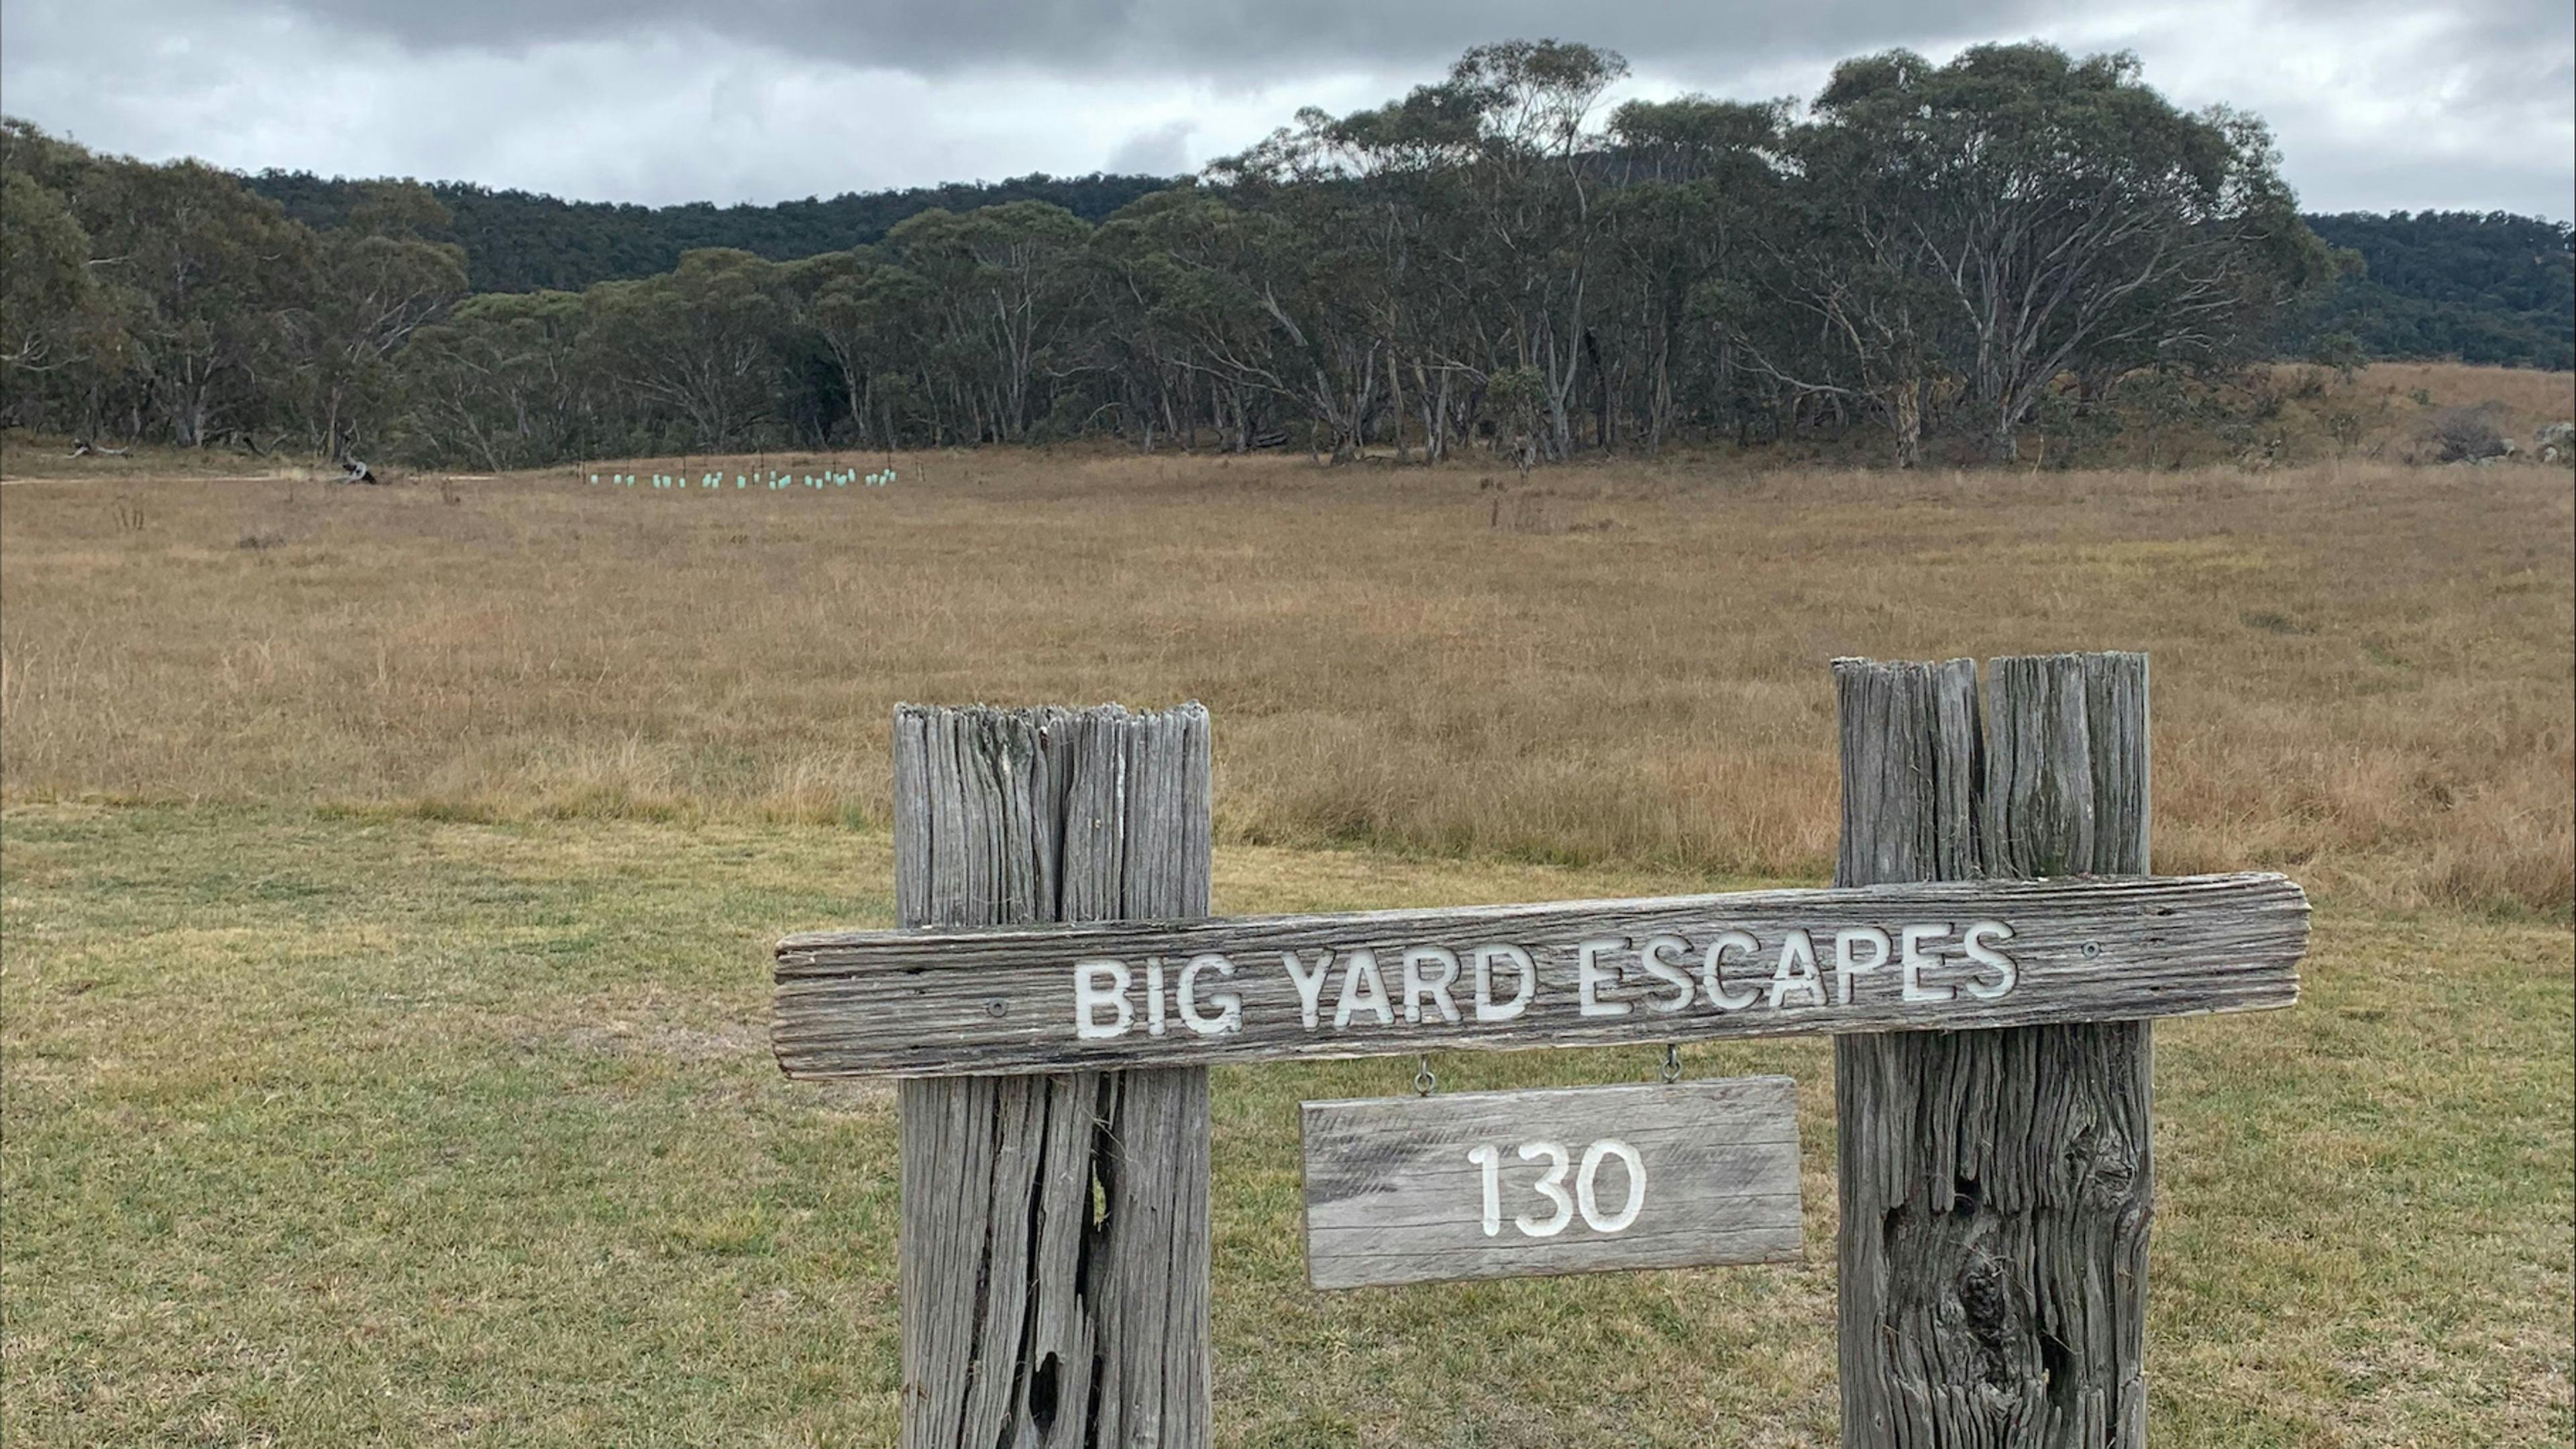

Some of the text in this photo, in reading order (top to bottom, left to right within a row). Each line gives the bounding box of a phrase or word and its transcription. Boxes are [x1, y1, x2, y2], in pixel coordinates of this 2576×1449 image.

[1074, 920, 2019, 1040] BIG YARD ESCAPES
[1468, 1138, 1647, 1237] 130
